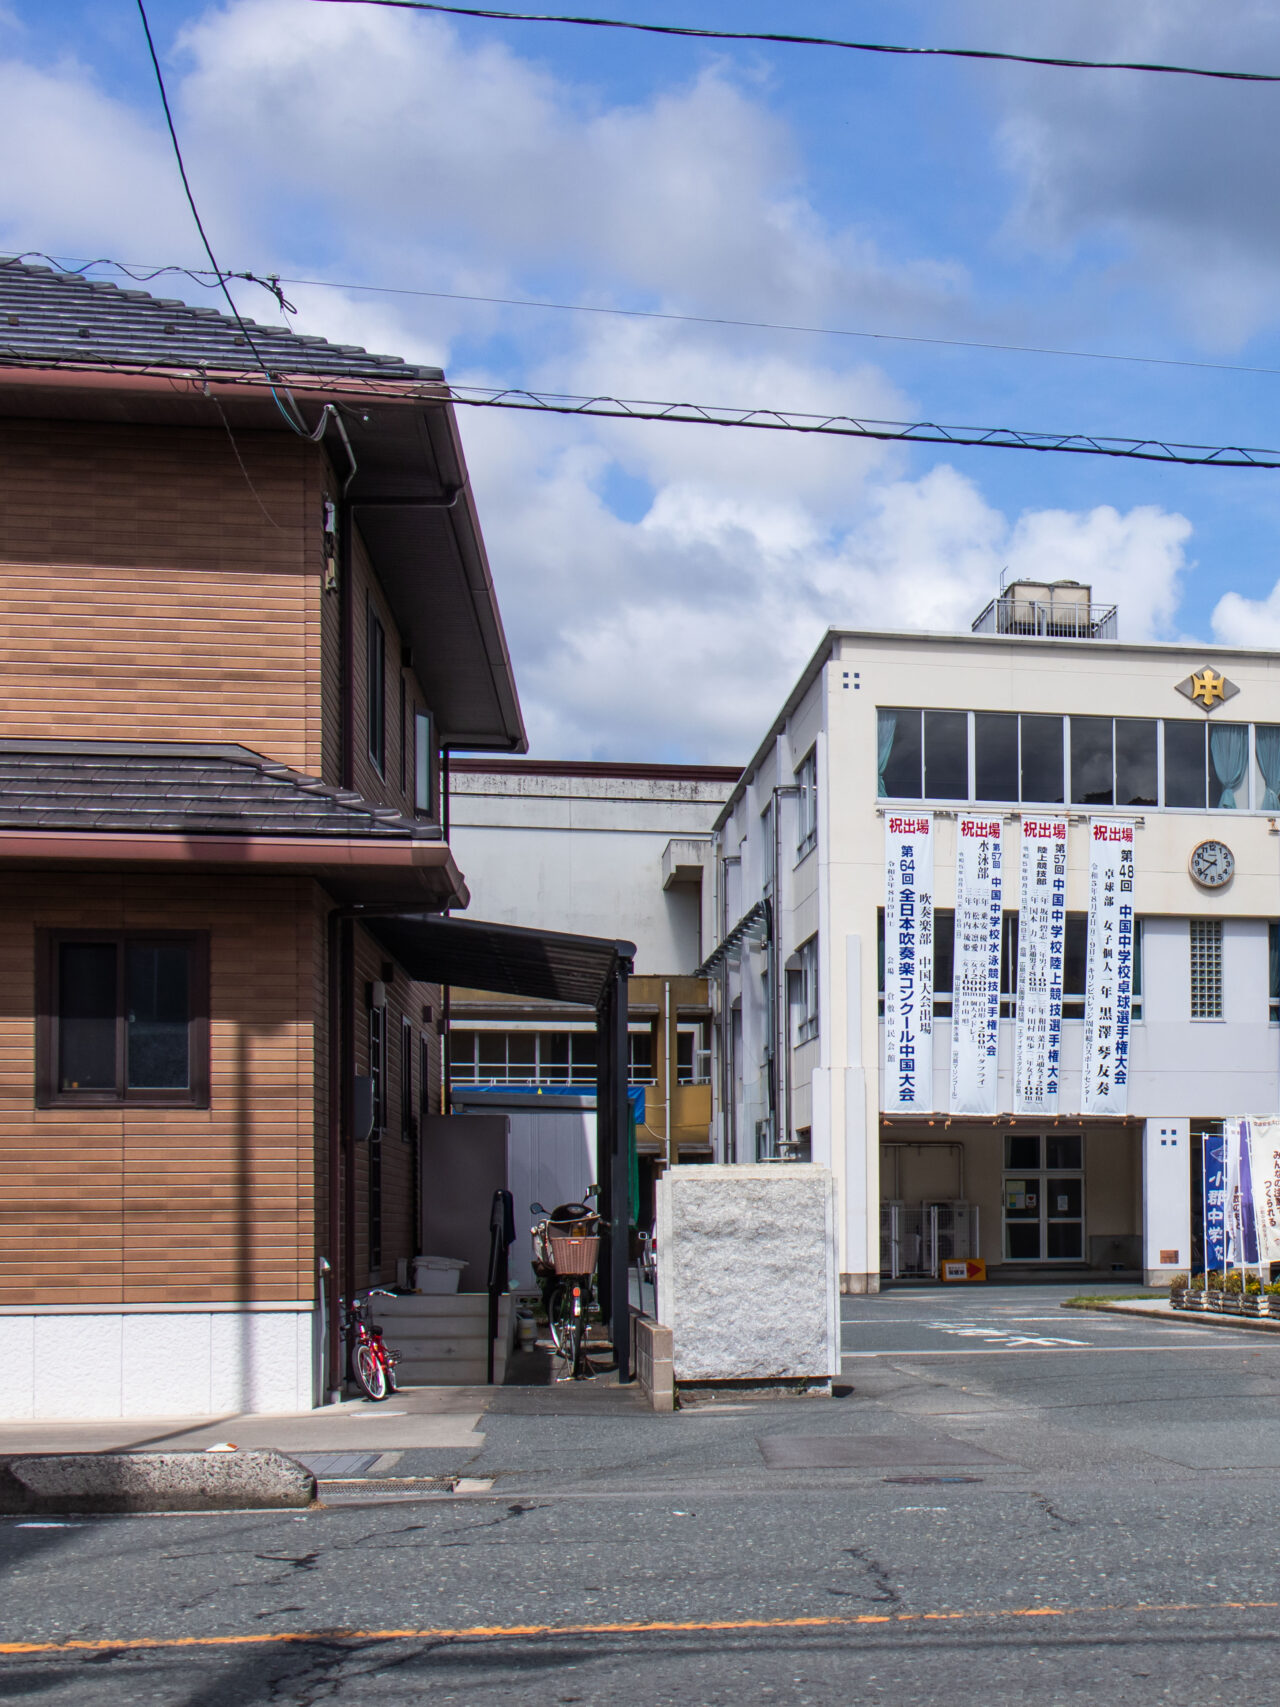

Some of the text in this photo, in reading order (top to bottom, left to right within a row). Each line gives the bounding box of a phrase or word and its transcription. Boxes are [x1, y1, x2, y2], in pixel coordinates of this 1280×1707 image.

[889, 817, 930, 835] 祝出場
[961, 820, 1000, 839] 祝出場
[1023, 821, 1067, 840] 祝出場
[1093, 824, 1134, 843] 祝出場
[977, 839, 990, 880] 水泳部
[1036, 845, 1048, 886] 陸上競技部
[1114, 849, 1134, 1085] 第48回 中国中学校卓球選手権大会
